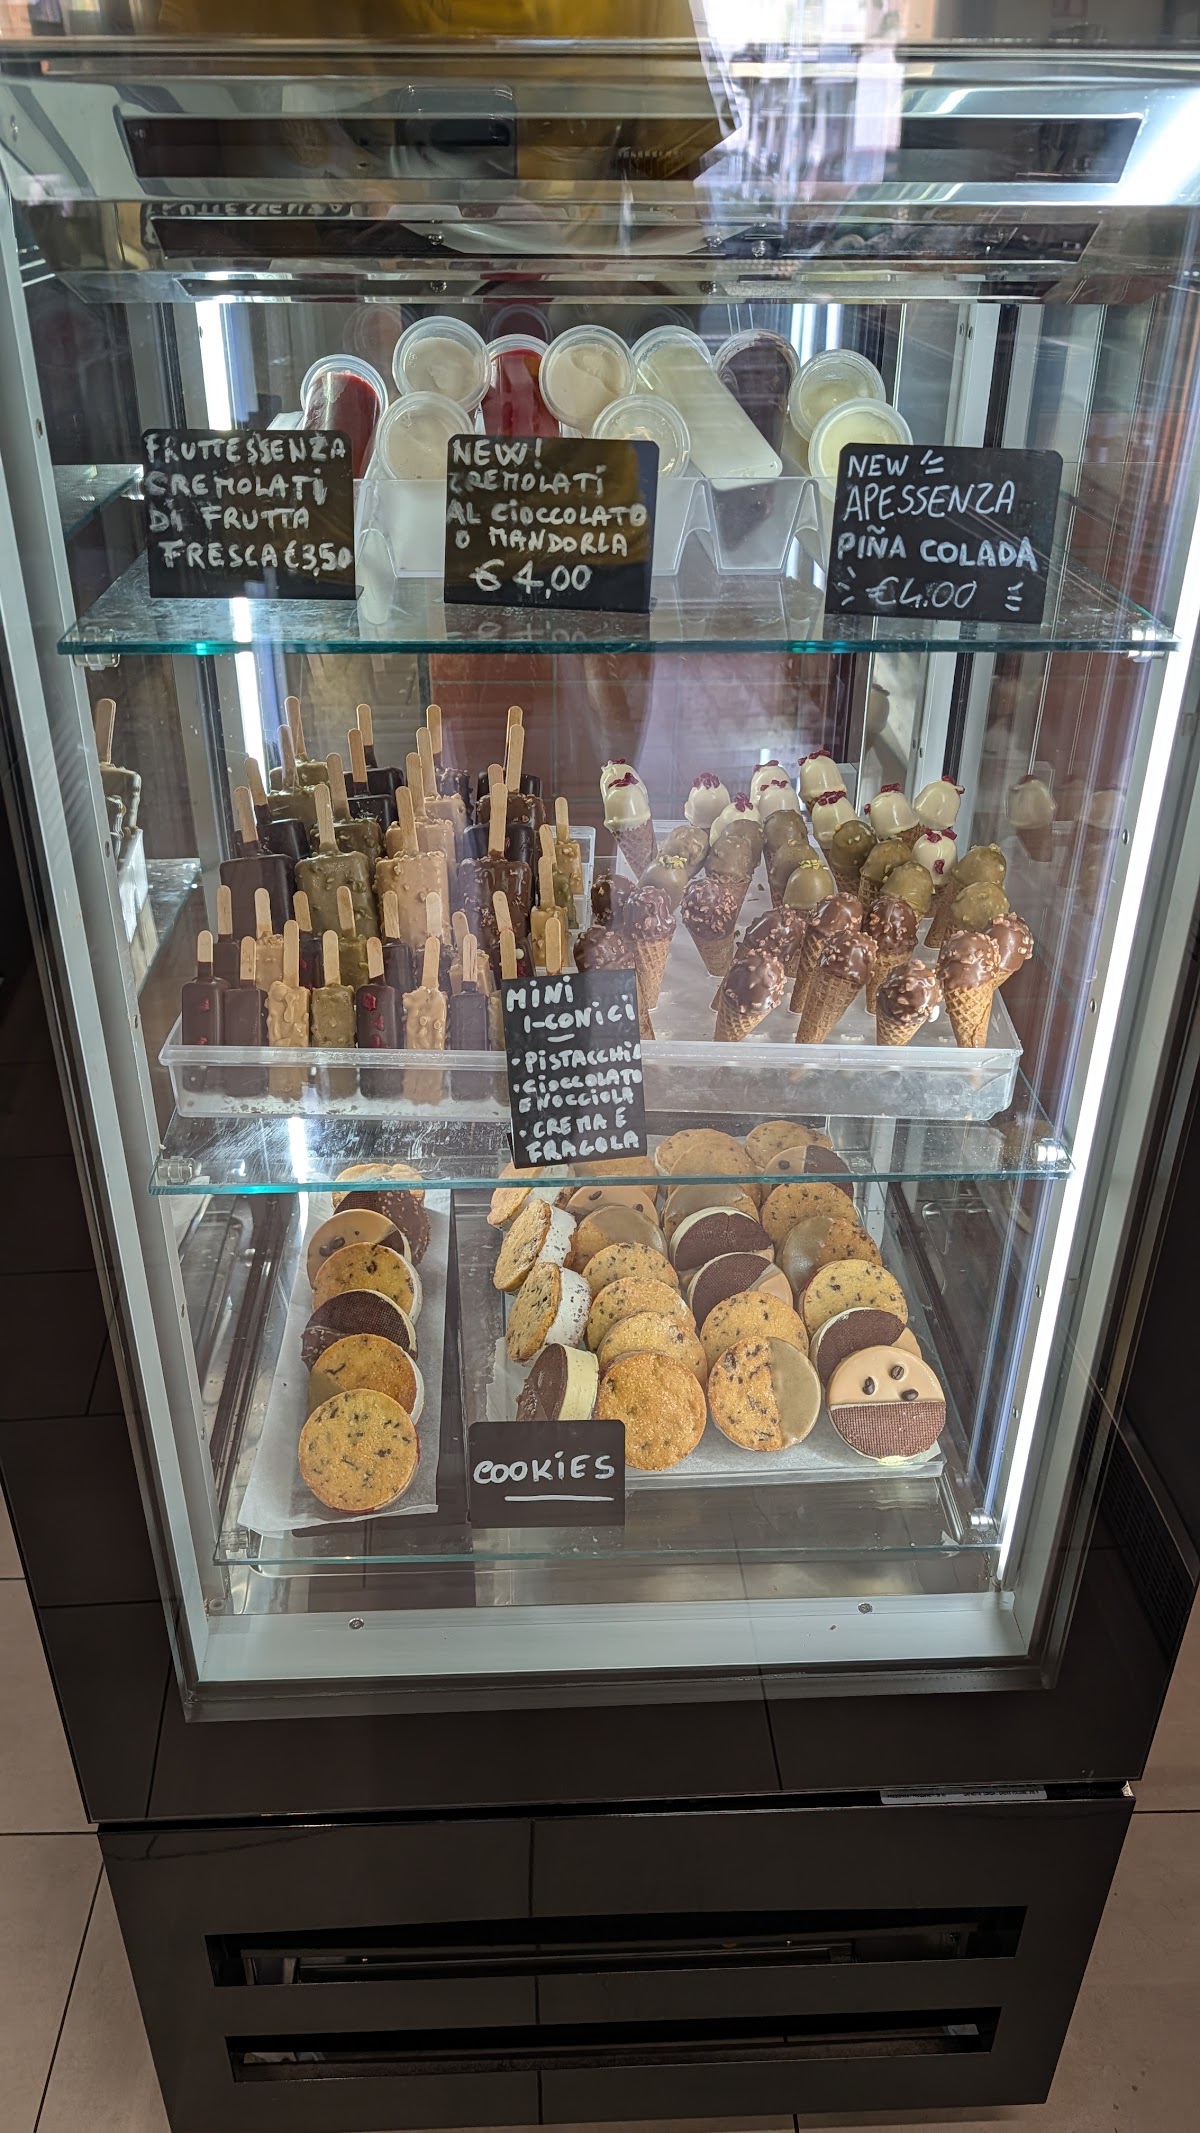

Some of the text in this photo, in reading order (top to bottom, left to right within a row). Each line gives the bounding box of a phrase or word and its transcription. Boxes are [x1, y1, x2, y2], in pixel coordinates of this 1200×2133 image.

[144, 432, 346, 465] FRUTTESSENZA
[453, 438, 542, 469] NEW!
[847, 454, 909, 478] NEW
[447, 499, 481, 526] AL
[842, 480, 1016, 521] APESSENZA
[200, 506, 310, 531] FRUTTA
[158, 538, 278, 569] FRESCA
[488, 525, 628, 557] MANDORLA
[837, 524, 1038, 572] PIÑA COLADA
[533, 1107, 627, 1138] CREMA E
